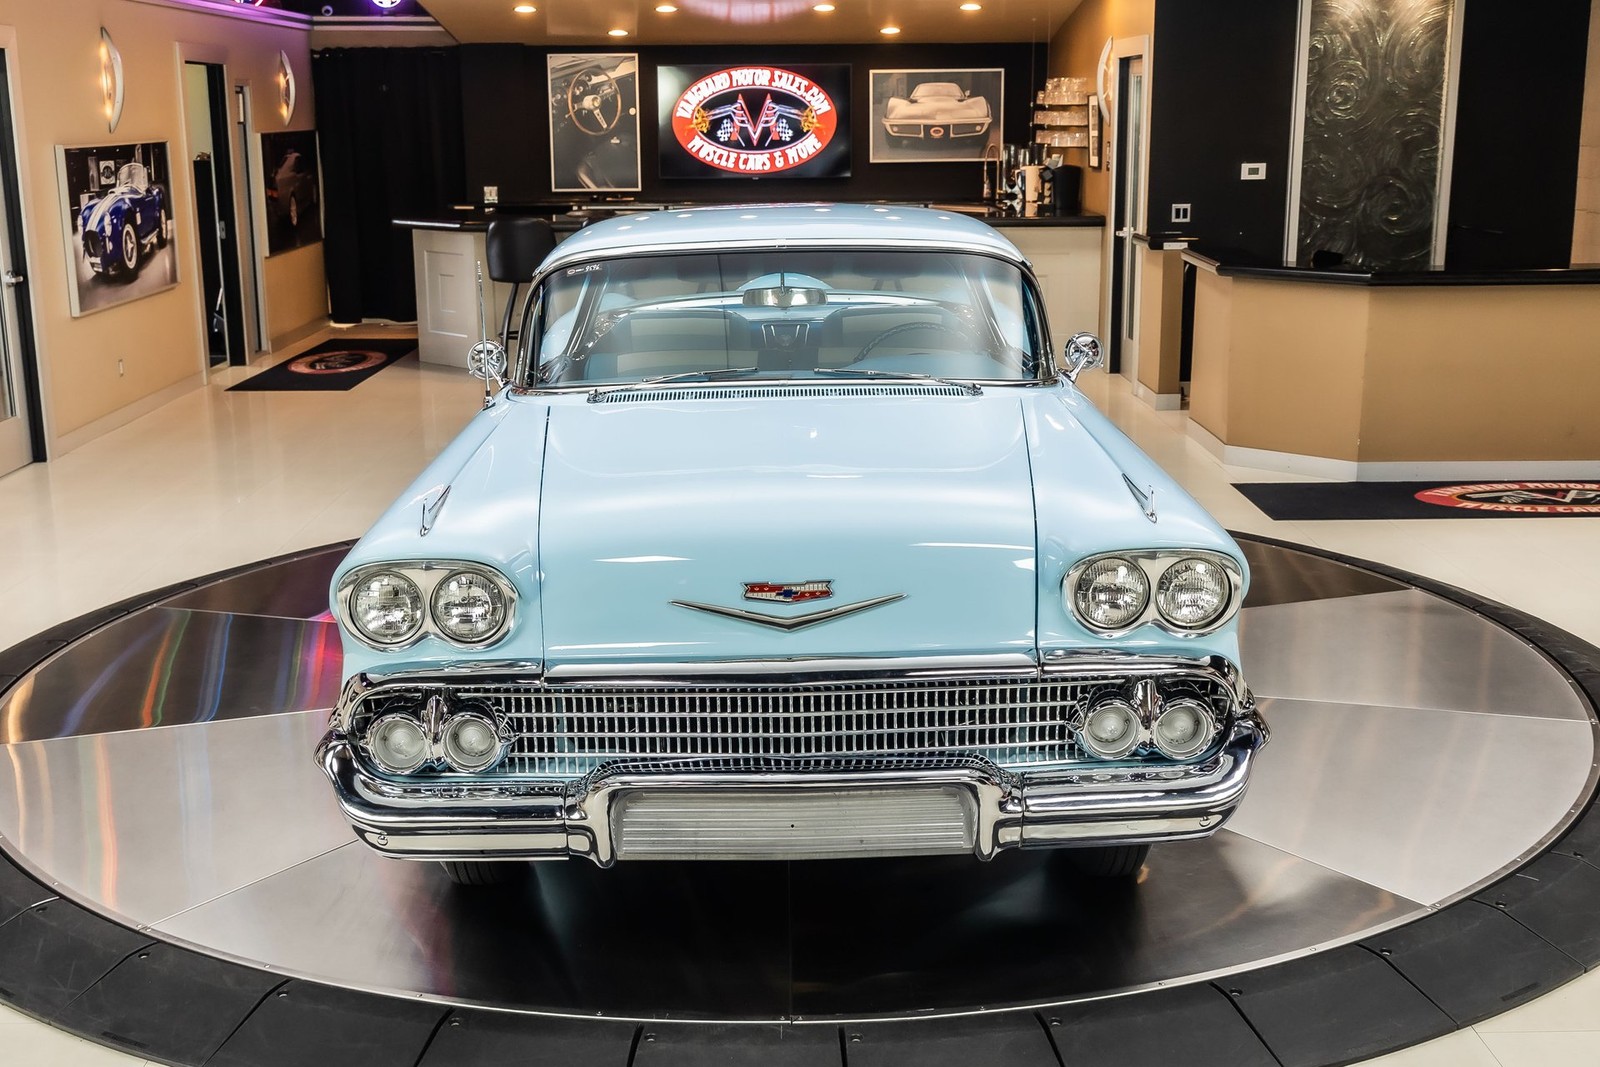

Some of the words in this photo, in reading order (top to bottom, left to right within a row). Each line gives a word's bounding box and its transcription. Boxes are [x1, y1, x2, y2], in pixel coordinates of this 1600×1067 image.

[676, 72, 730, 118] VANGUARD
[731, 69, 771, 87] MOTOR
[772, 70, 832, 115] SALES.COM
[687, 135, 738, 169] MUSCLE
[738, 153, 771, 171] CARS
[774, 151, 785, 168] &
[786, 133, 822, 165] MORE
